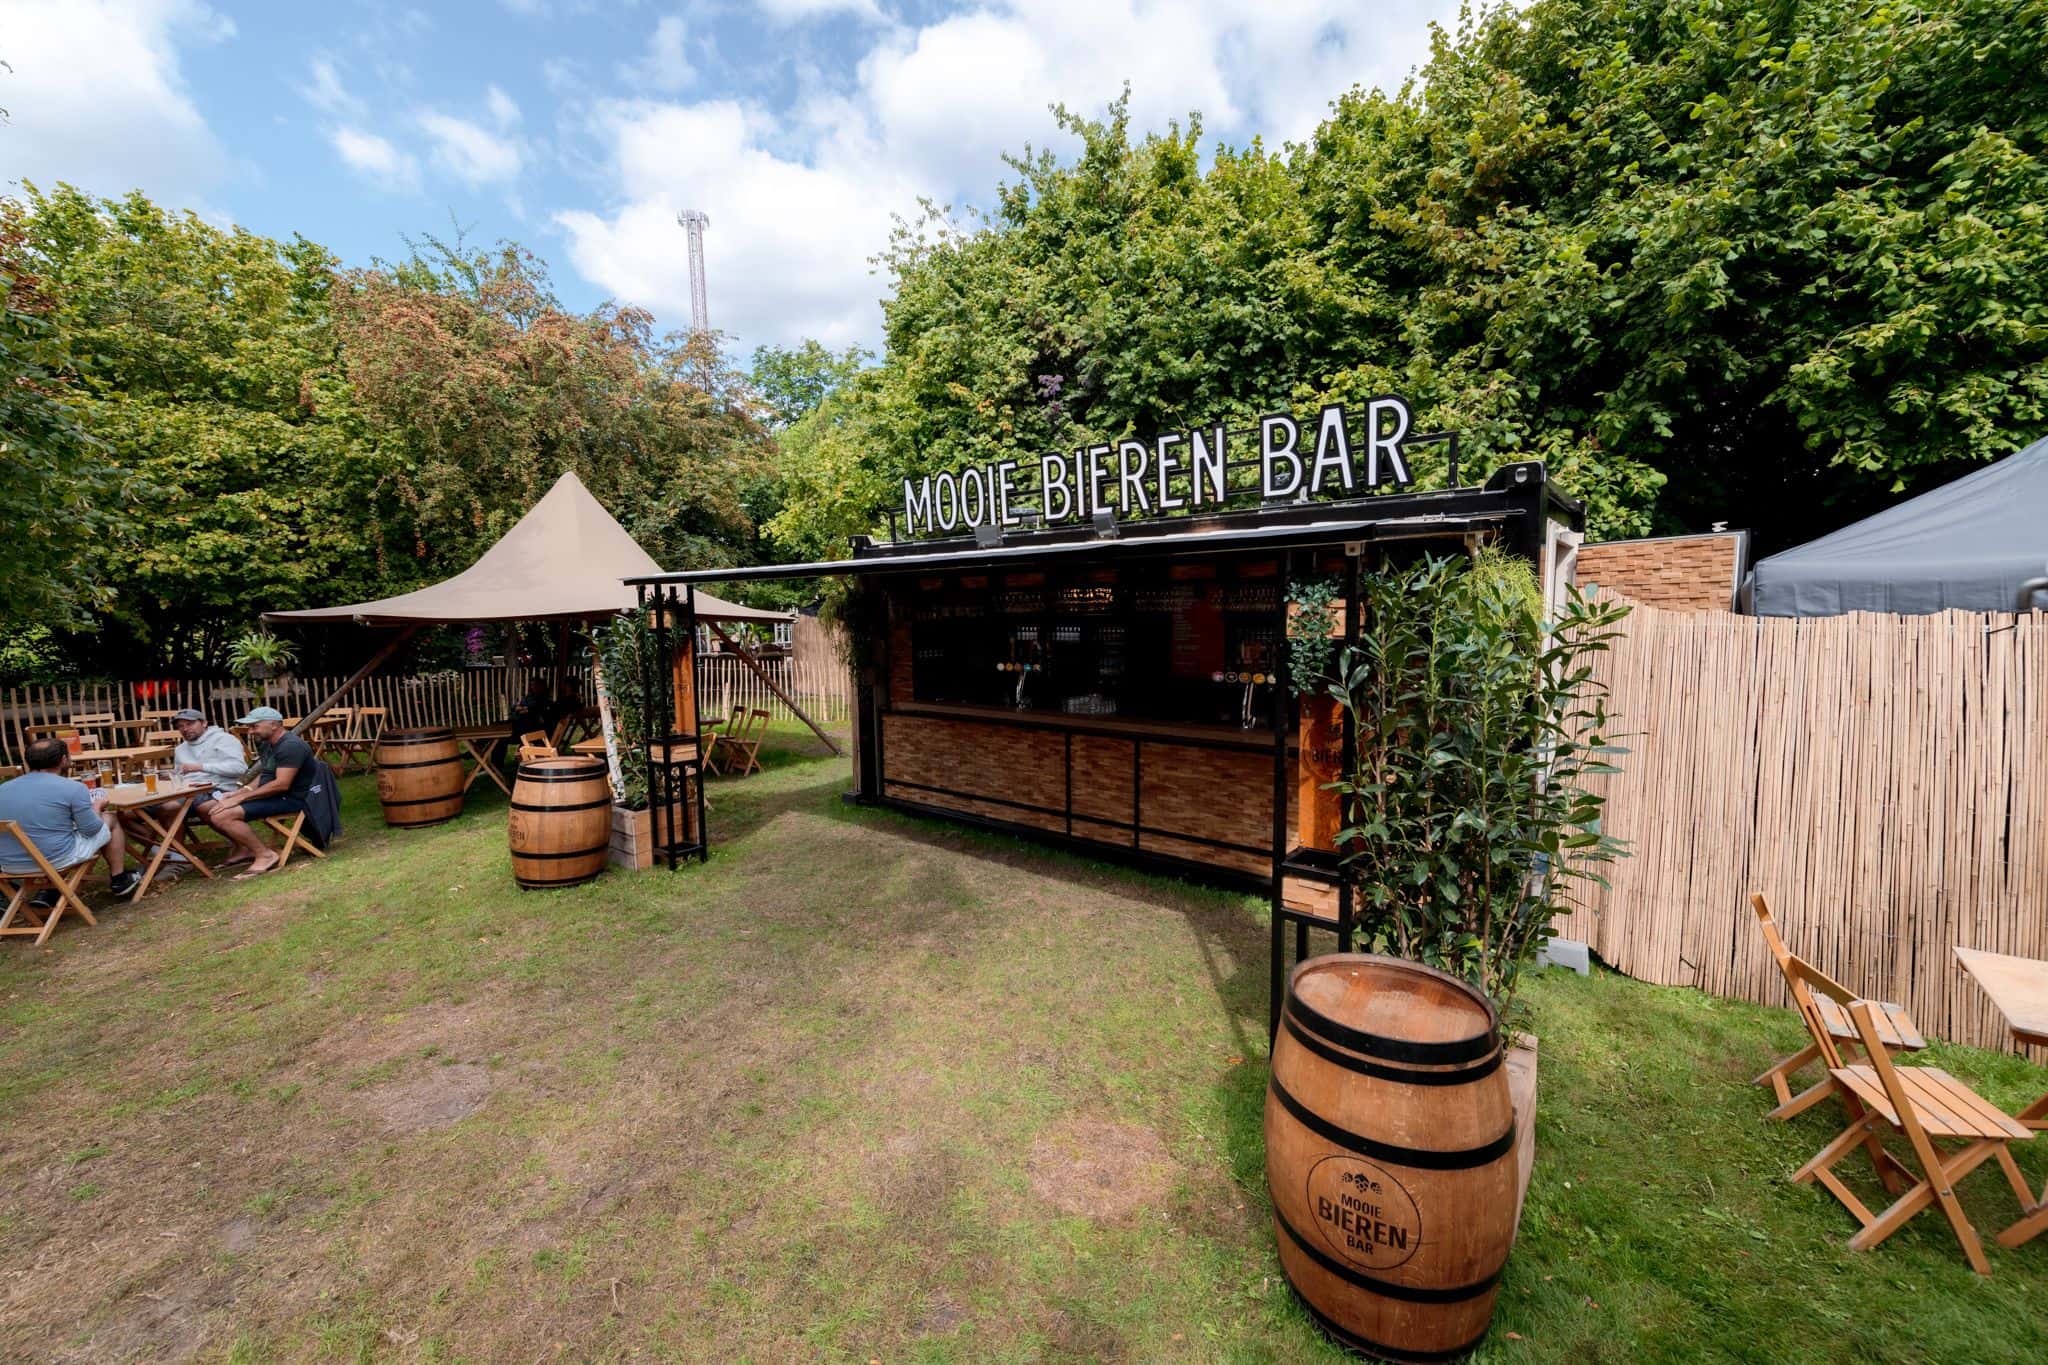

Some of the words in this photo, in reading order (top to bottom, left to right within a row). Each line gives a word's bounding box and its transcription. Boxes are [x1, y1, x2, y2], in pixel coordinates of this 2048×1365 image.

[904, 464, 1019, 534] MOOIE
[1041, 427, 1225, 521] BIEREN
[1261, 399, 1411, 497] BAR
[1318, 1196, 1407, 1250] BIEREN
[1340, 1193, 1382, 1218] MOOIE
[1346, 1235, 1374, 1256] BAR
